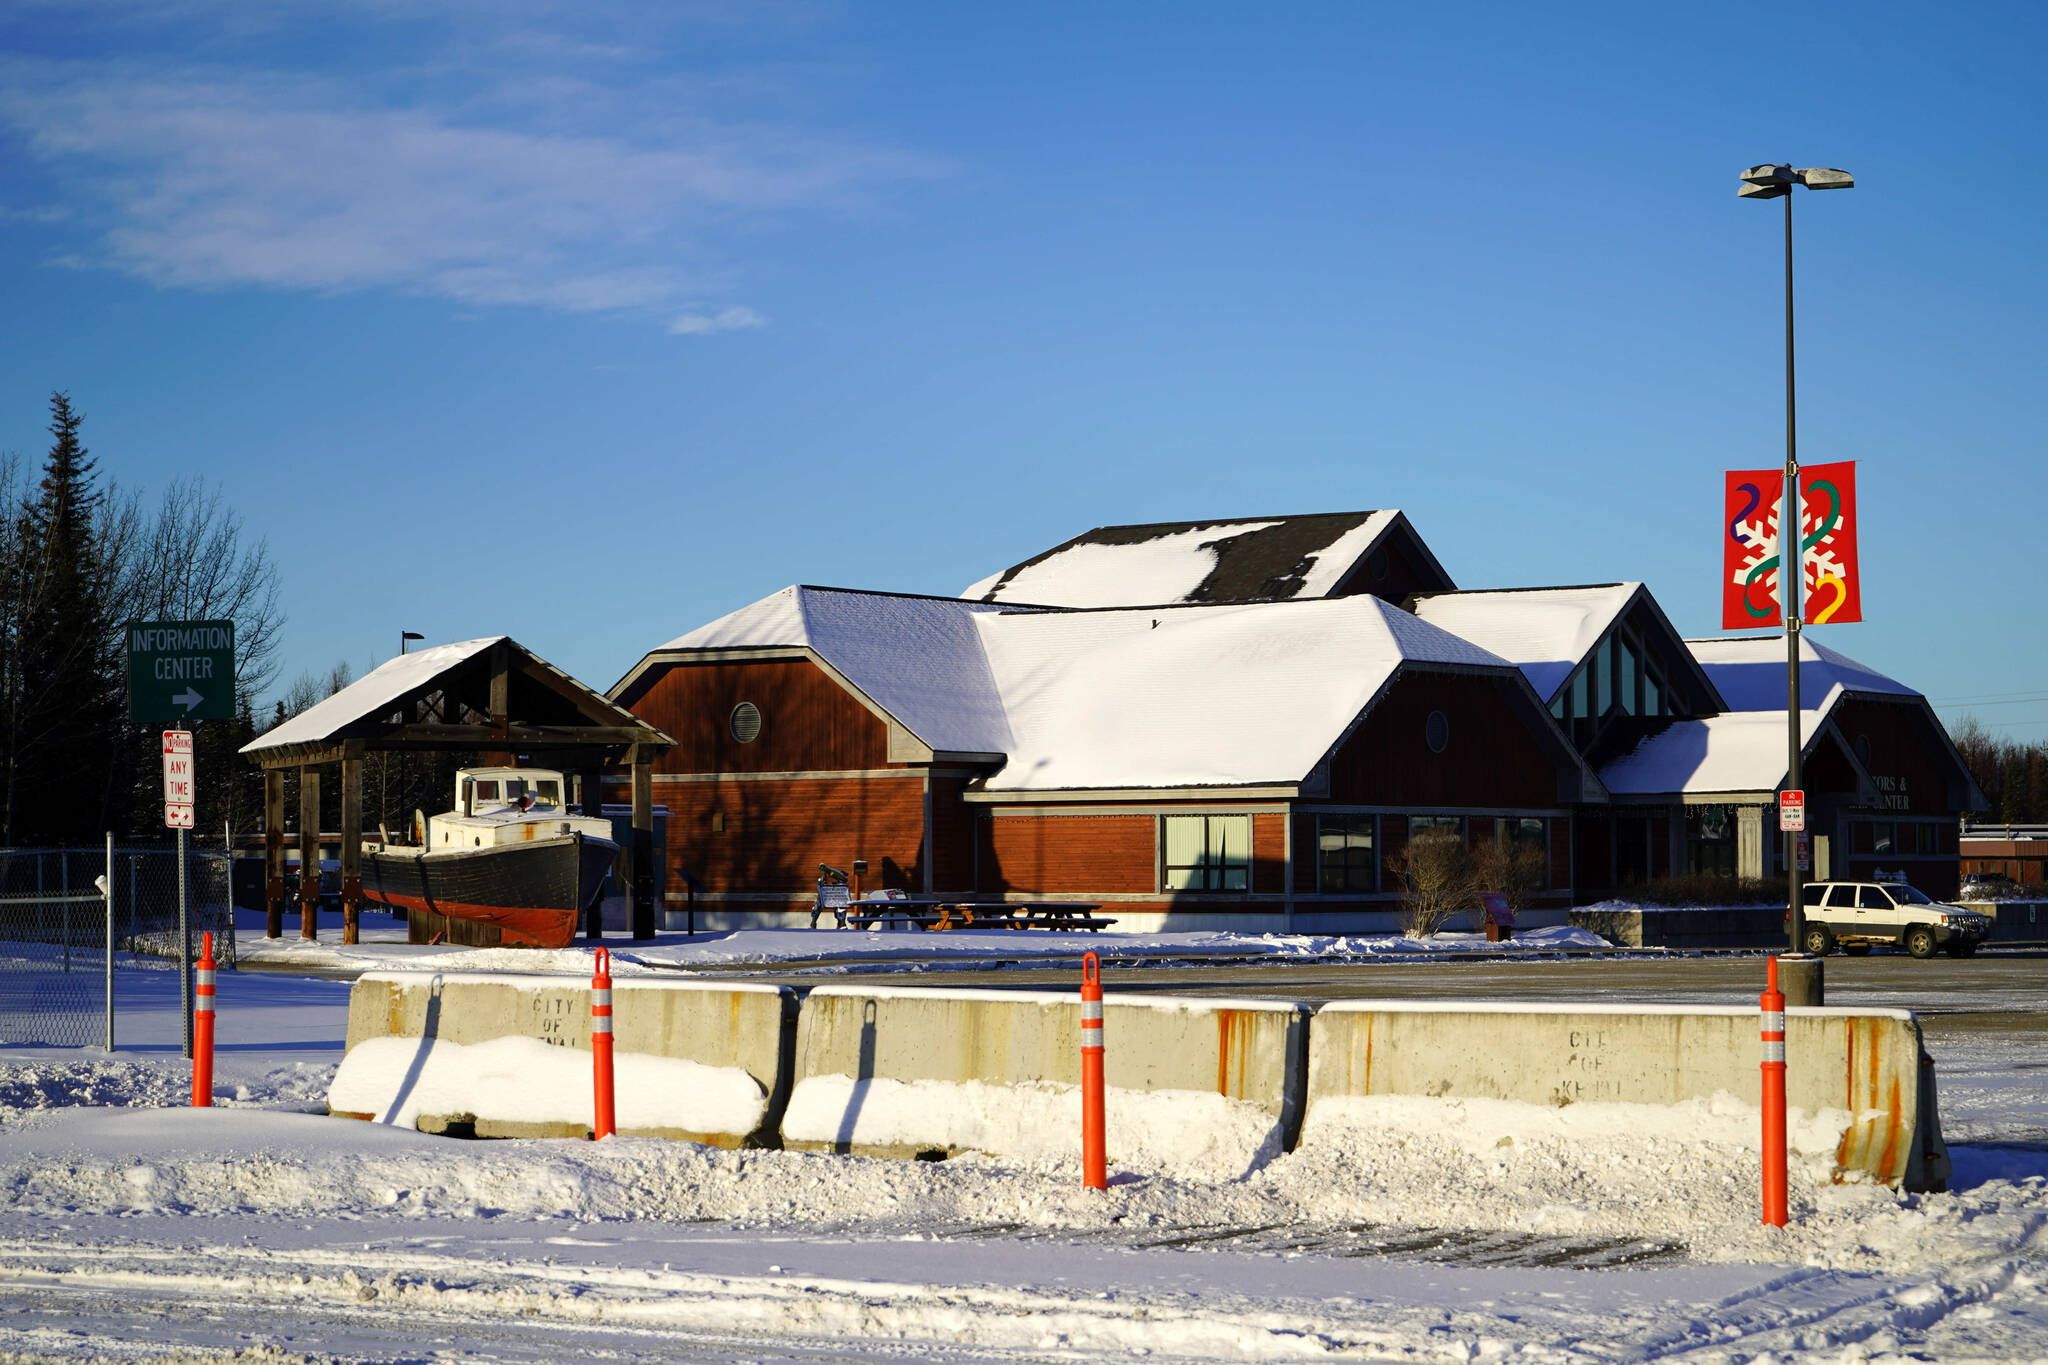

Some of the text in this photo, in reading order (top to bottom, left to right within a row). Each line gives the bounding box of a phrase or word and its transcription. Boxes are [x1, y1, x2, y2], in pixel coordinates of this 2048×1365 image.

[132, 627, 231, 652] INFORMATION
[155, 657, 213, 680] CENTER
[164, 736, 191, 750] NO PARKING
[170, 761, 187, 775] ANY
[170, 781, 188, 796] TIME
[1900, 776, 1907, 791] &
[1876, 794, 1909, 810] ENTER
[533, 998, 574, 1014] CITY
[543, 1018, 562, 1033] OF
